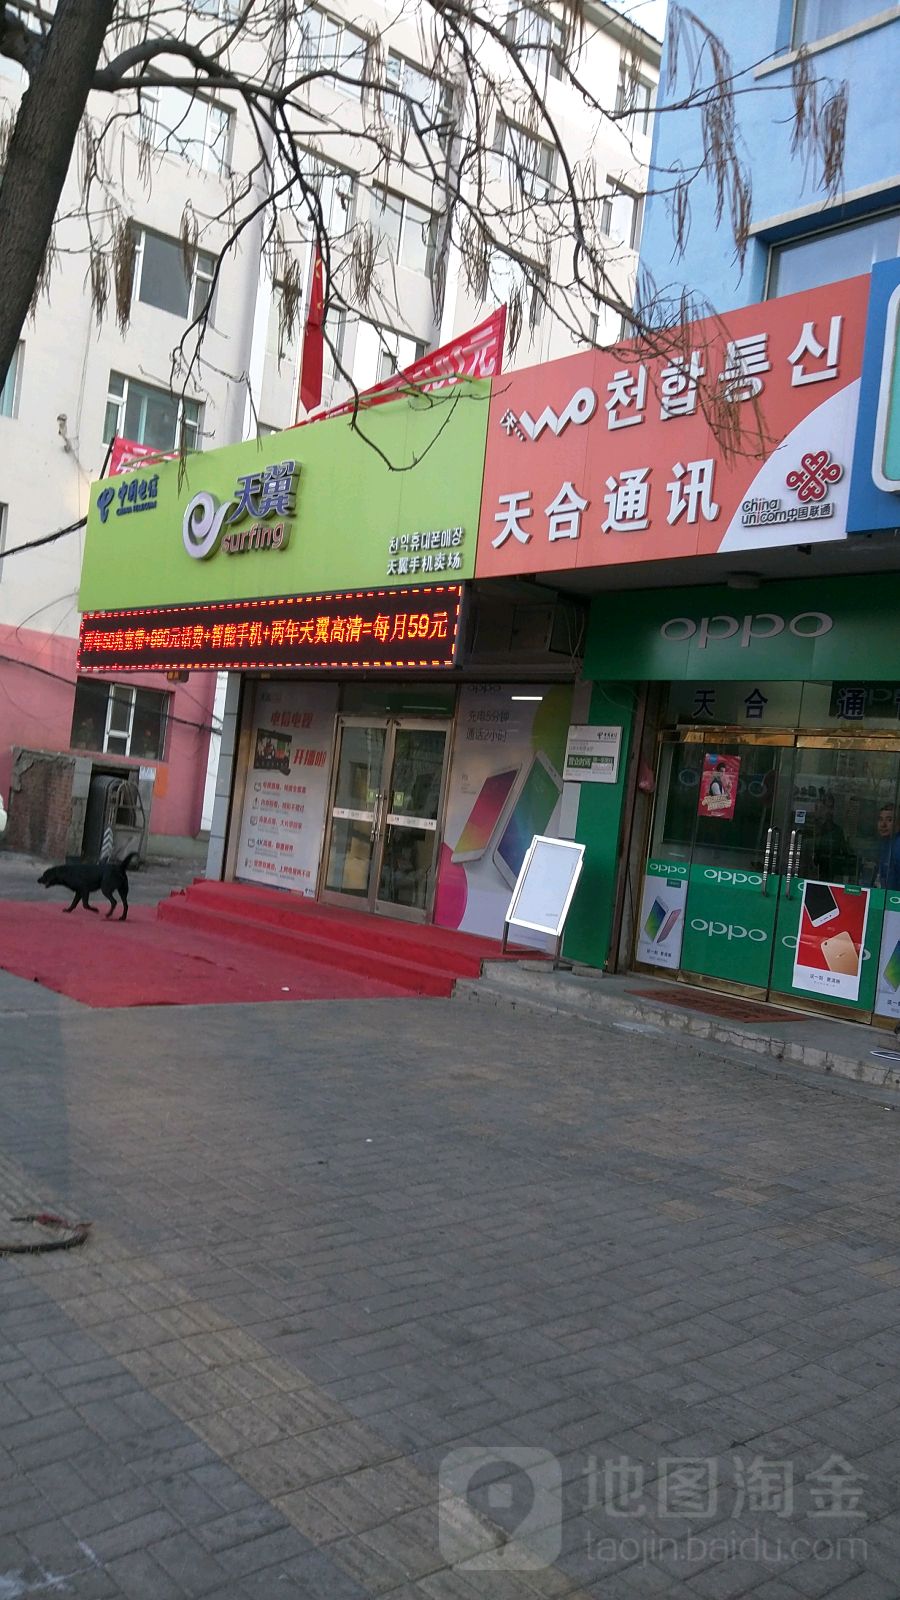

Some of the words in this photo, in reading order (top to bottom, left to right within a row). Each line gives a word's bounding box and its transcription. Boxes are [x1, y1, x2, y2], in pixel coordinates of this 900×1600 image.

[605, 315, 845, 431] 천합통신
[228, 460, 299, 524] 天翼
[491, 459, 720, 549] 天合通讯
[742, 510, 787, 524] unicom
[787, 503, 831, 520] 中国联通
[221, 522, 288, 554] surfing
[387, 552, 462, 575] 天翼手机卖场
[692, 688, 900, 720] 天合通
